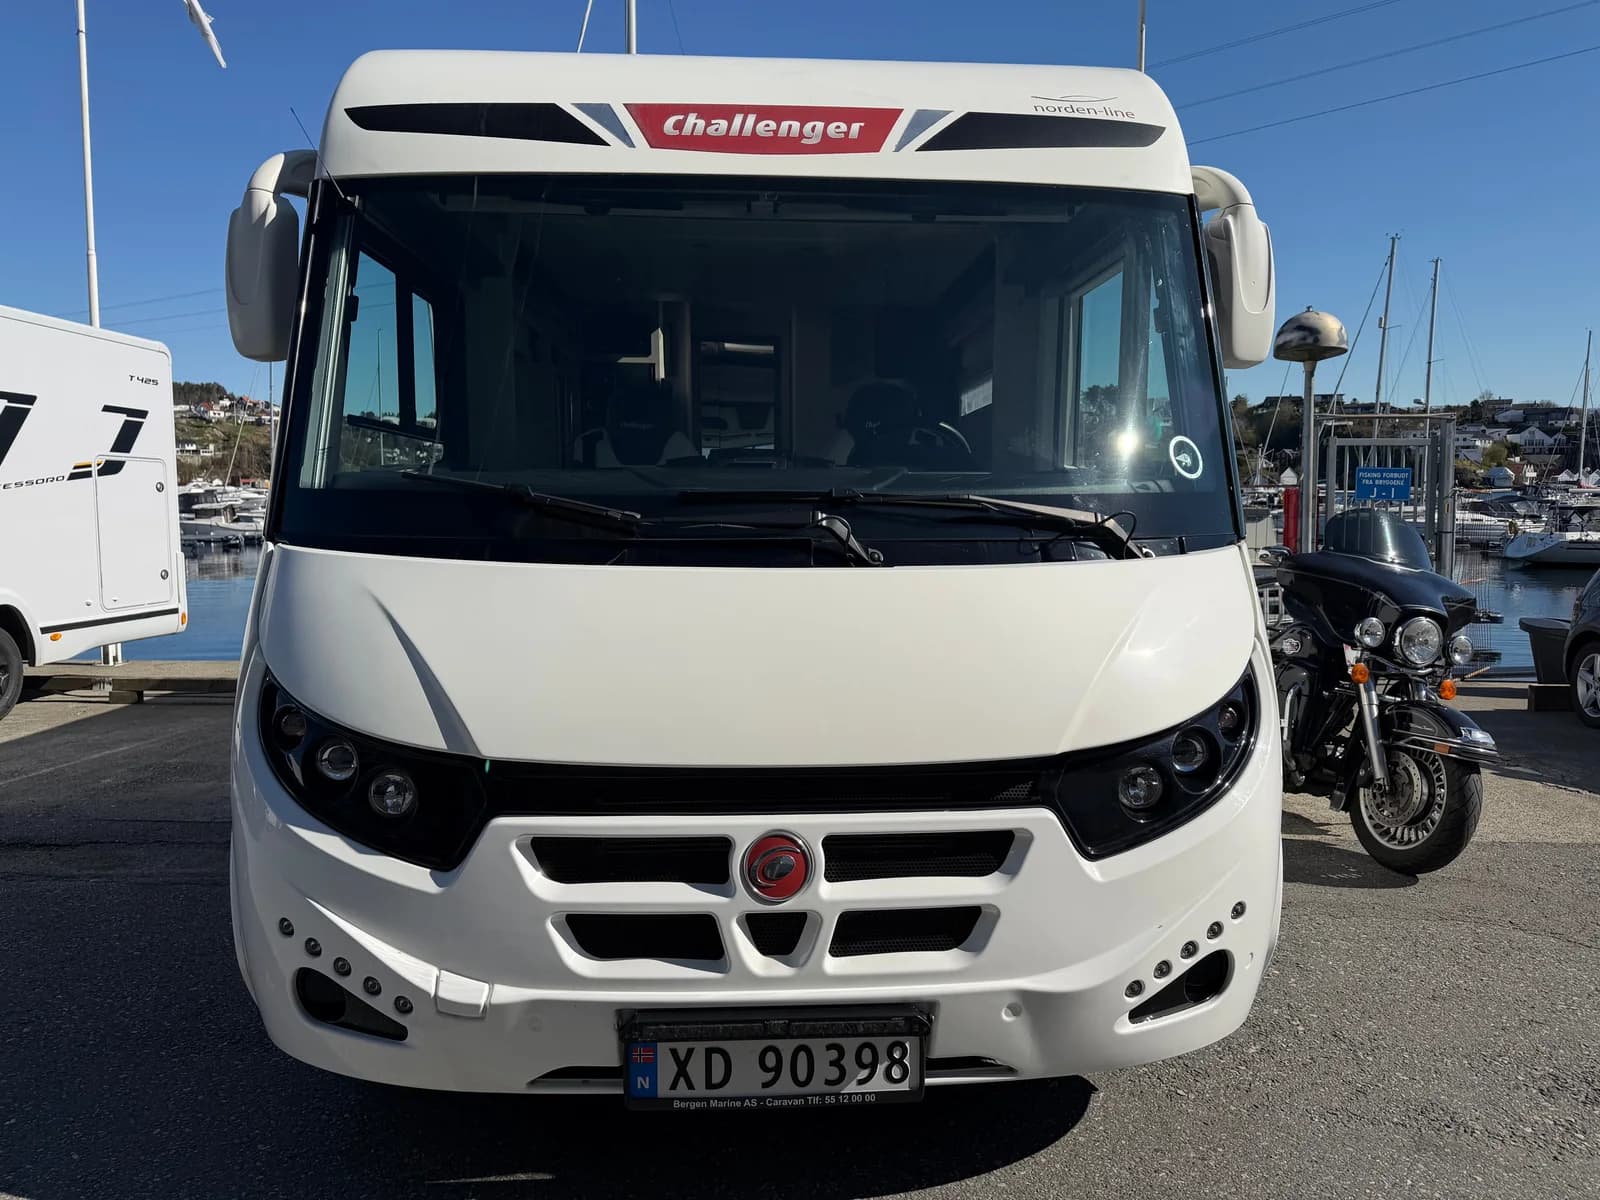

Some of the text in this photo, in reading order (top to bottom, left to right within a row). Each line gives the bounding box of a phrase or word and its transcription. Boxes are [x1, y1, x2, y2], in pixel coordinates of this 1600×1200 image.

[1033, 102, 1136, 120] norden-line
[663, 113, 864, 144] Challenger
[128, 374, 159, 386] T 425
[0, 475, 65, 490] ESSORO
[669, 1040, 911, 1090] XD 90398
[637, 1077, 649, 1089] N
[673, 1099, 707, 1110] Bergen
[709, 1099, 742, 1109] Marine
[743, 1098, 758, 1108] AS
[766, 1096, 805, 1107] Caravan
[825, 1095, 836, 1105] 55
[838, 1095, 849, 1104] 12
[851, 1094, 862, 1104] 00
[865, 1093, 876, 1103] 00
